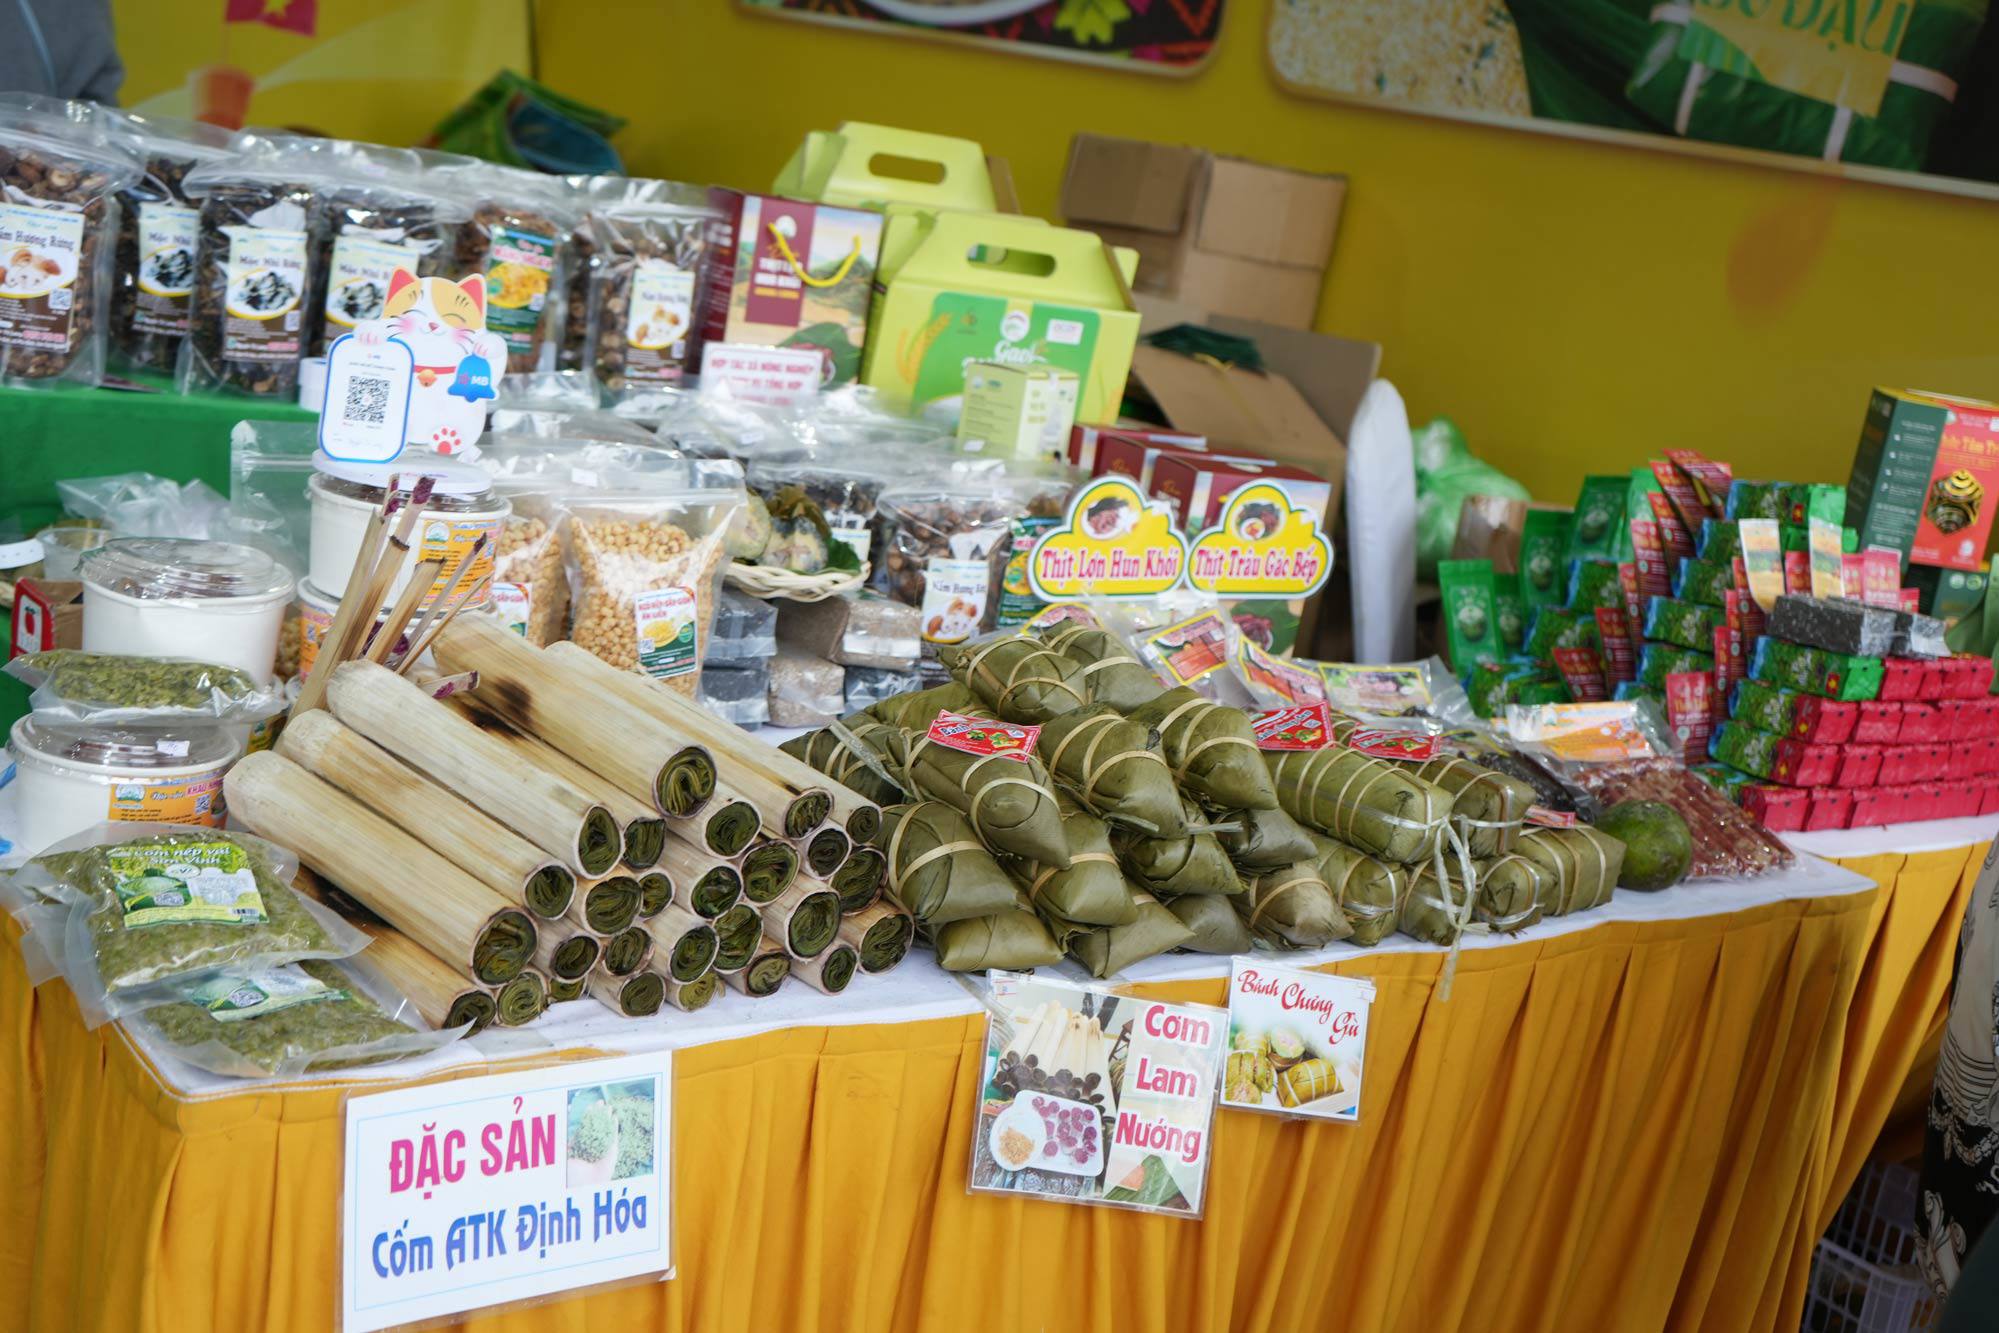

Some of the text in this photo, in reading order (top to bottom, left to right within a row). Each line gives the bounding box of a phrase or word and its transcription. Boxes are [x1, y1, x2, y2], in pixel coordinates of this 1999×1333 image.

[471, 377, 489, 386] MB
[1042, 549, 1074, 588] Thịt
[1078, 549, 1106, 587] Lợn
[1110, 549, 1139, 578] Hun
[1195, 545, 1318, 585] Thịt Trâu Gác Bếp
[1145, 1004, 1210, 1045] Cơm
[1238, 970, 1359, 1045] Bánh Chưng Gù
[1136, 1057, 1197, 1097] Lam
[389, 1096, 556, 1200] ĐẶC SẢN
[1115, 1112, 1202, 1163] Nướng
[372, 1187, 647, 1279] Cốm ATK Định Hóa
